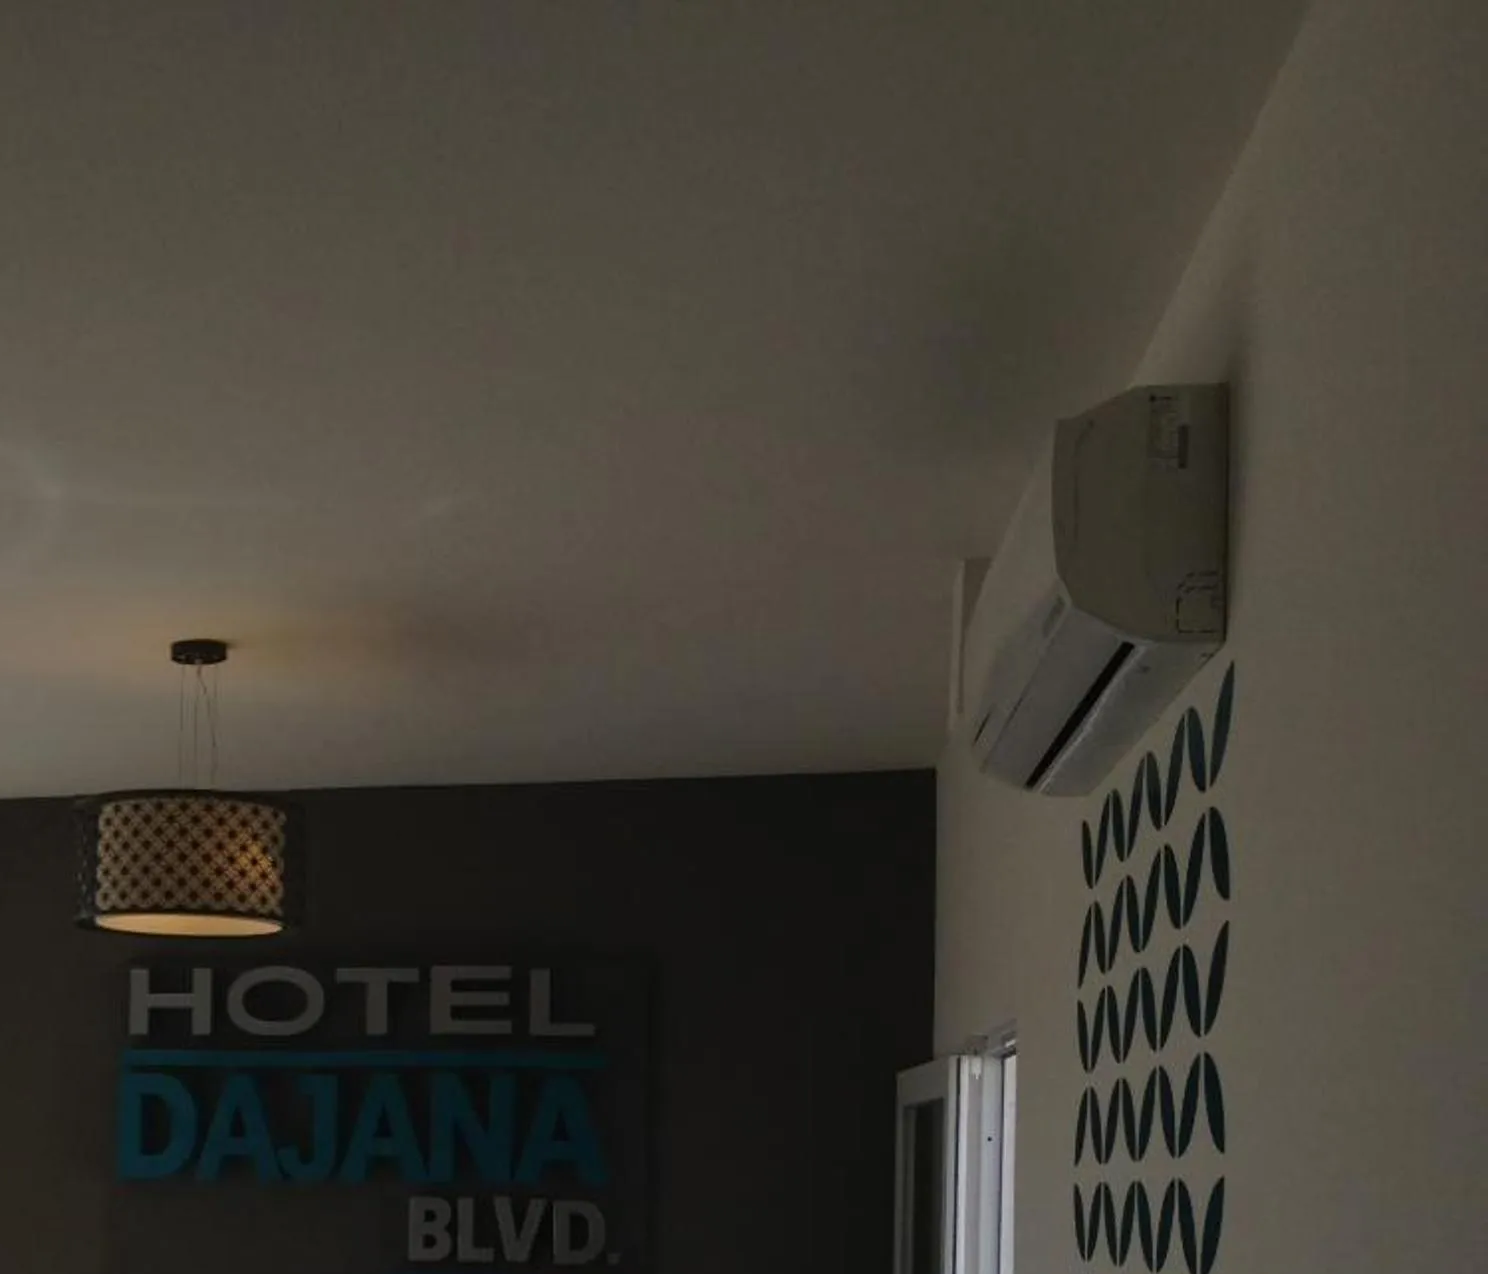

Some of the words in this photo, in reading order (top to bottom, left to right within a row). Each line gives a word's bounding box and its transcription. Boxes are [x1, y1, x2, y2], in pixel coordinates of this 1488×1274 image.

[128, 966, 595, 1036] HOTEL
[117, 1072, 608, 1184] DAJANA
[407, 1195, 621, 1265] BLVD.
